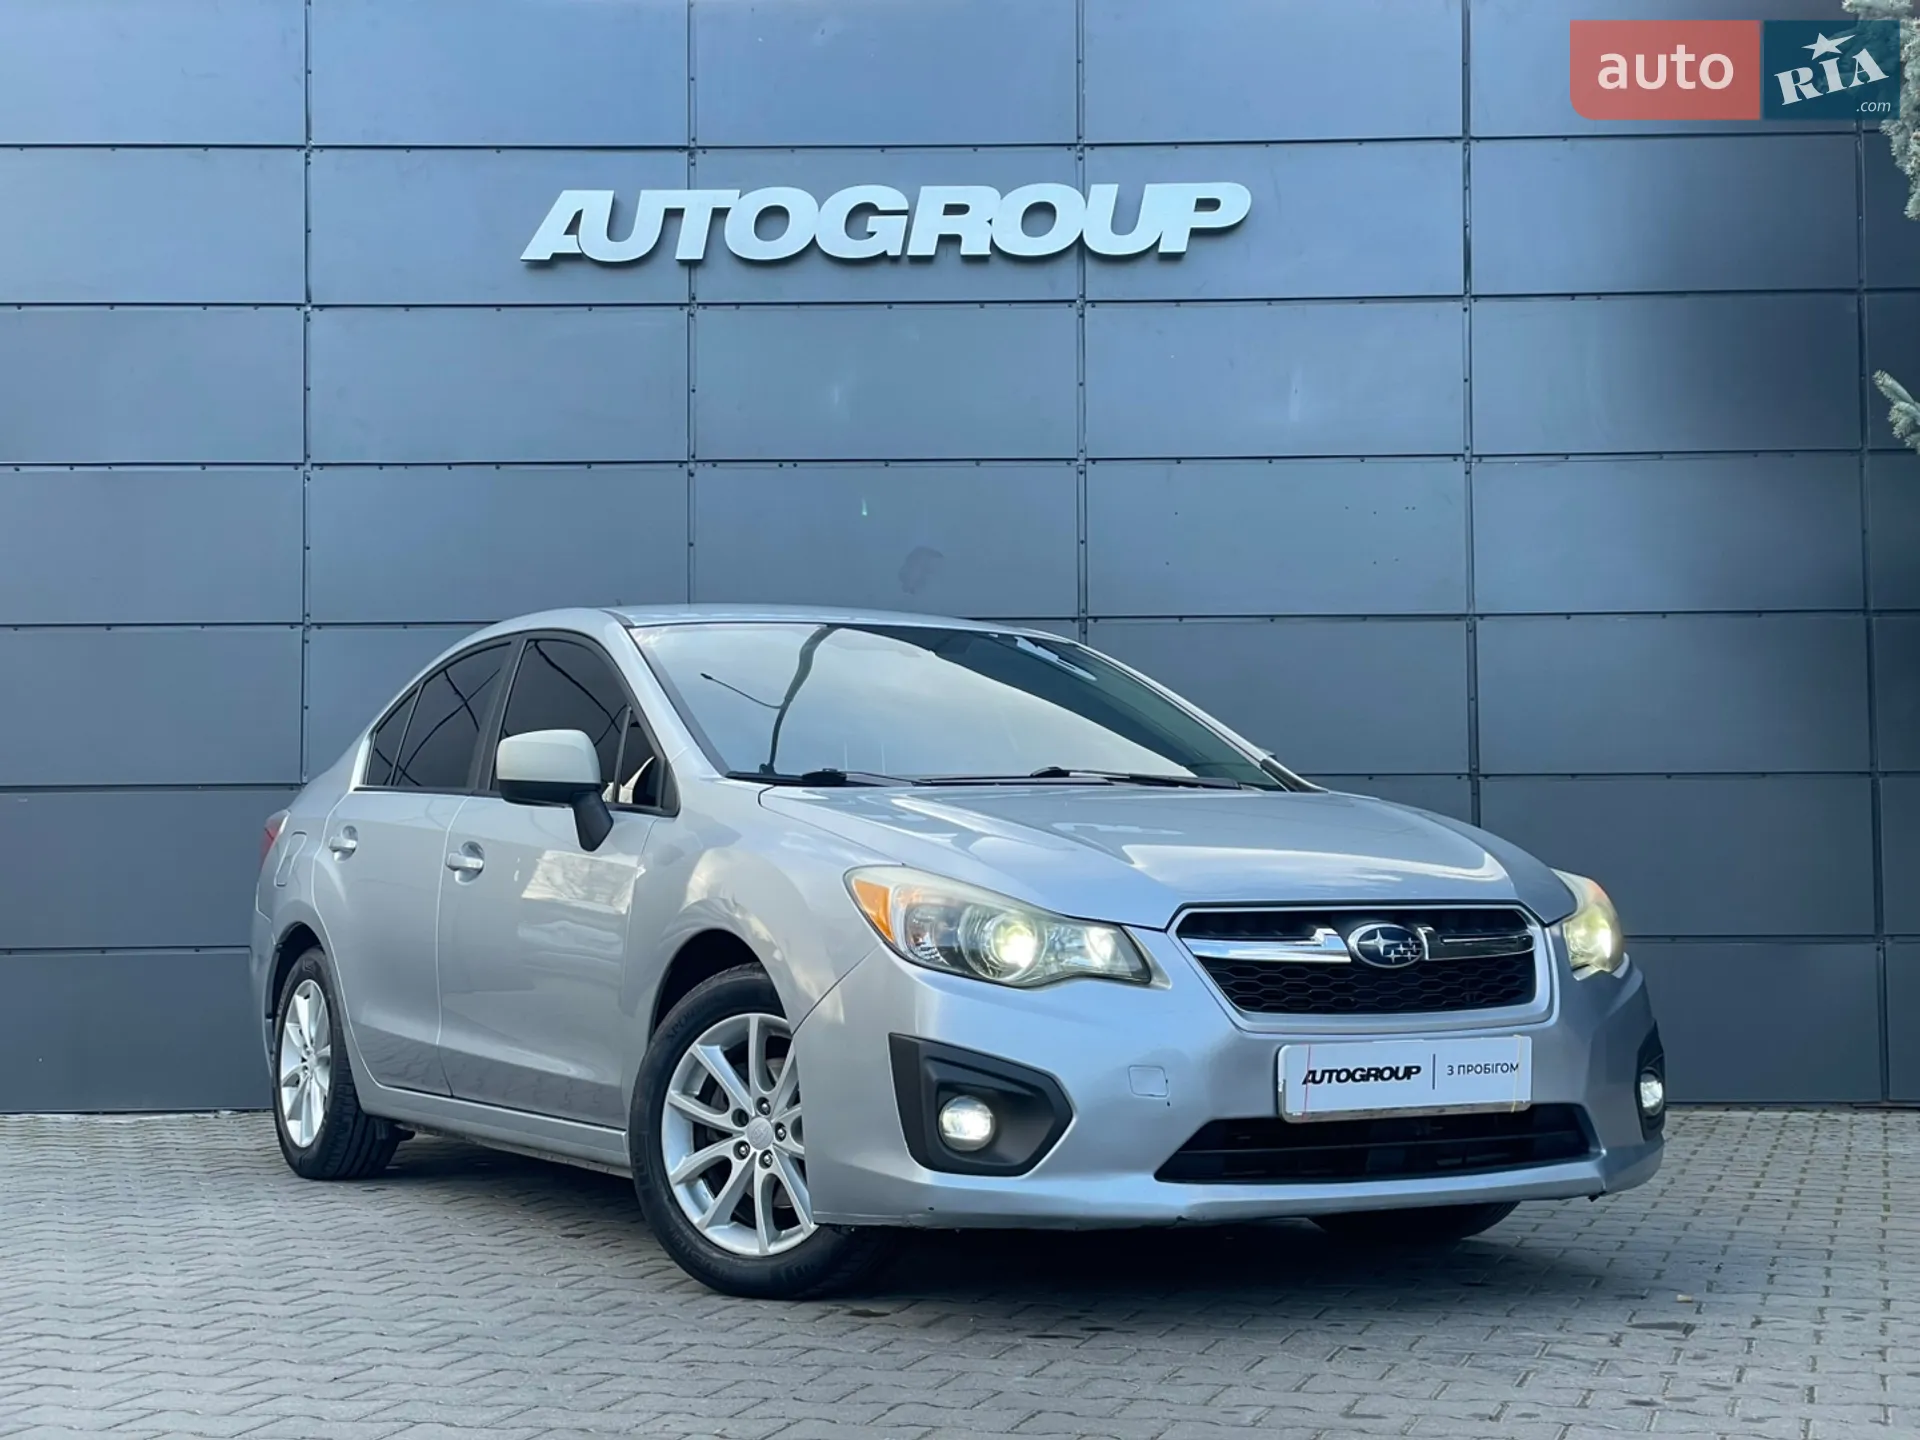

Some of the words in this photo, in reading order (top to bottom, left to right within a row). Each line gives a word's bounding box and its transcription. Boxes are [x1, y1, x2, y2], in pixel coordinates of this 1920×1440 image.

[520, 182, 1252, 262] AUTOGROUP
[1302, 1065, 1422, 1085] AUTOGROUP
[1457, 1062, 1520, 1076] ПРОБІГОМ
